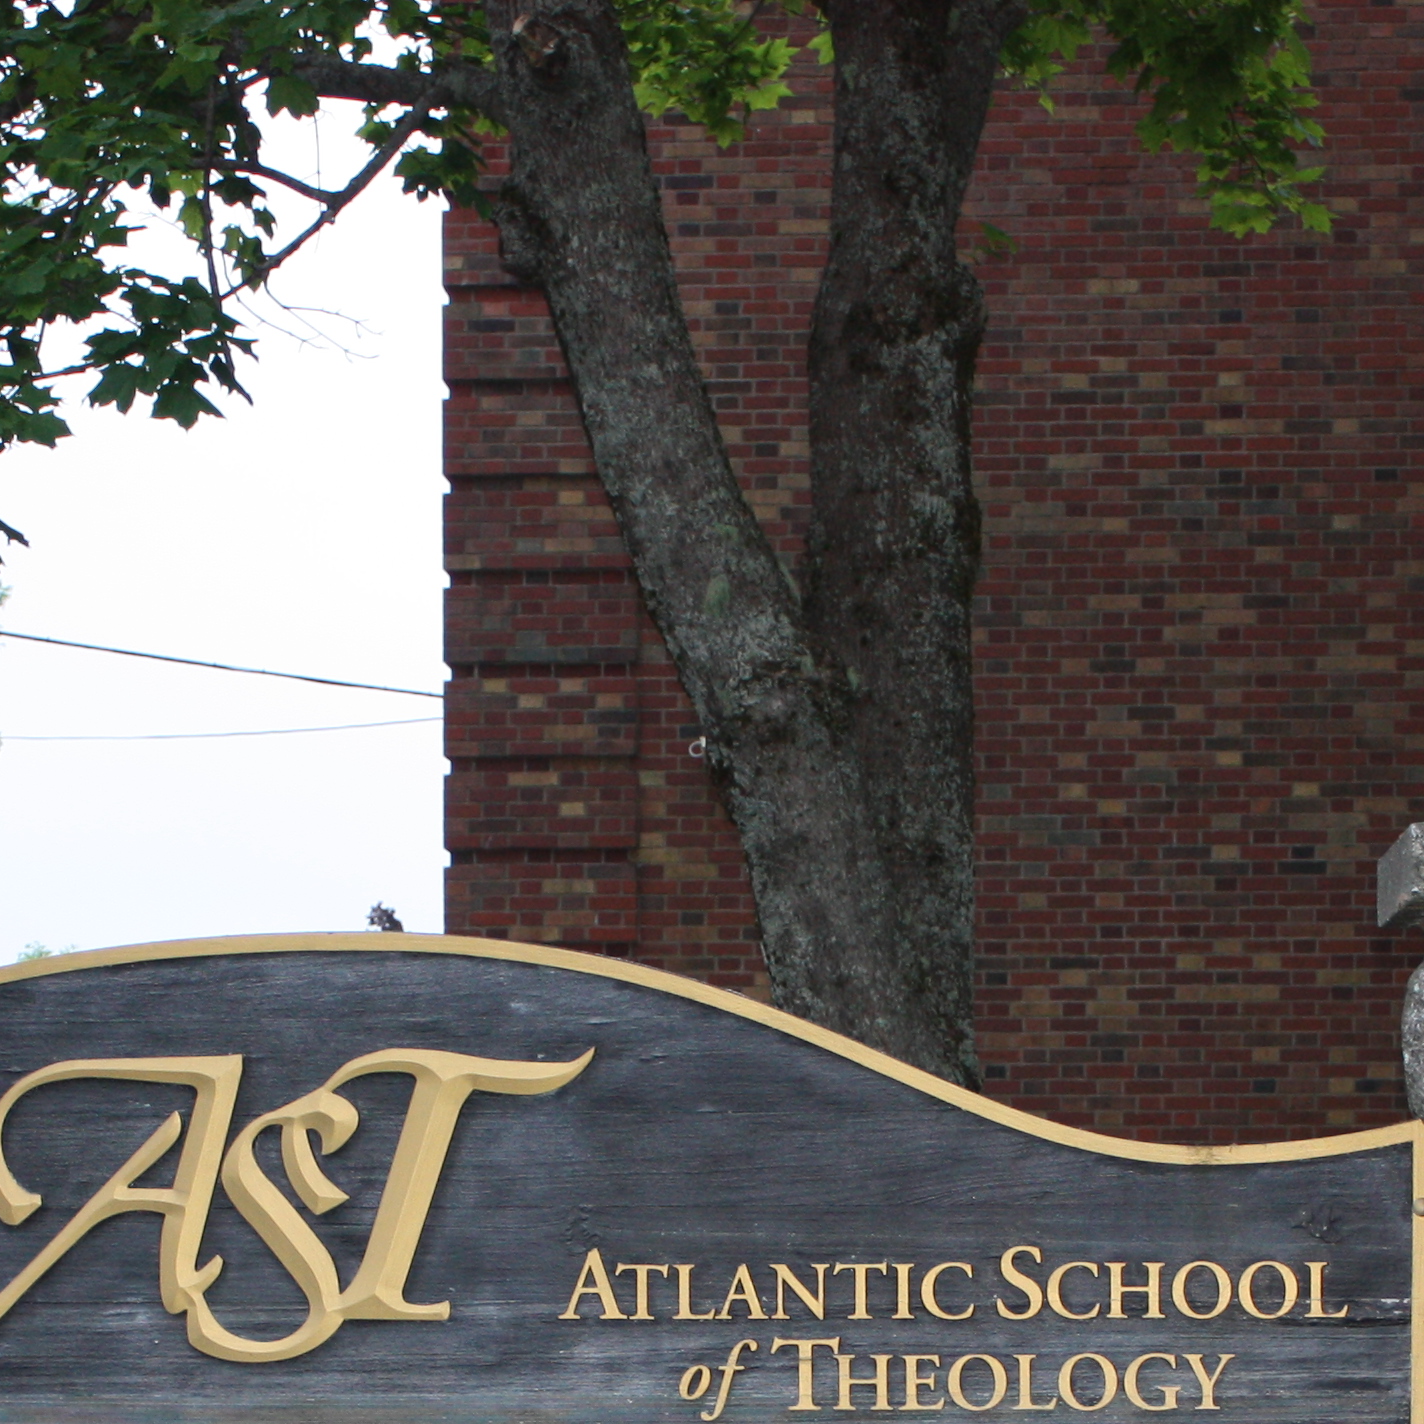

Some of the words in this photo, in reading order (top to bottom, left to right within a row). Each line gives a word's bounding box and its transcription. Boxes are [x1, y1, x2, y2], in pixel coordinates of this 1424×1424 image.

[559, 1249, 975, 1319] ATLANTIC
[996, 1246, 1349, 1319] SCHOOL
[679, 1339, 759, 1421] of
[771, 1338, 1234, 1411] THEOLOGY
